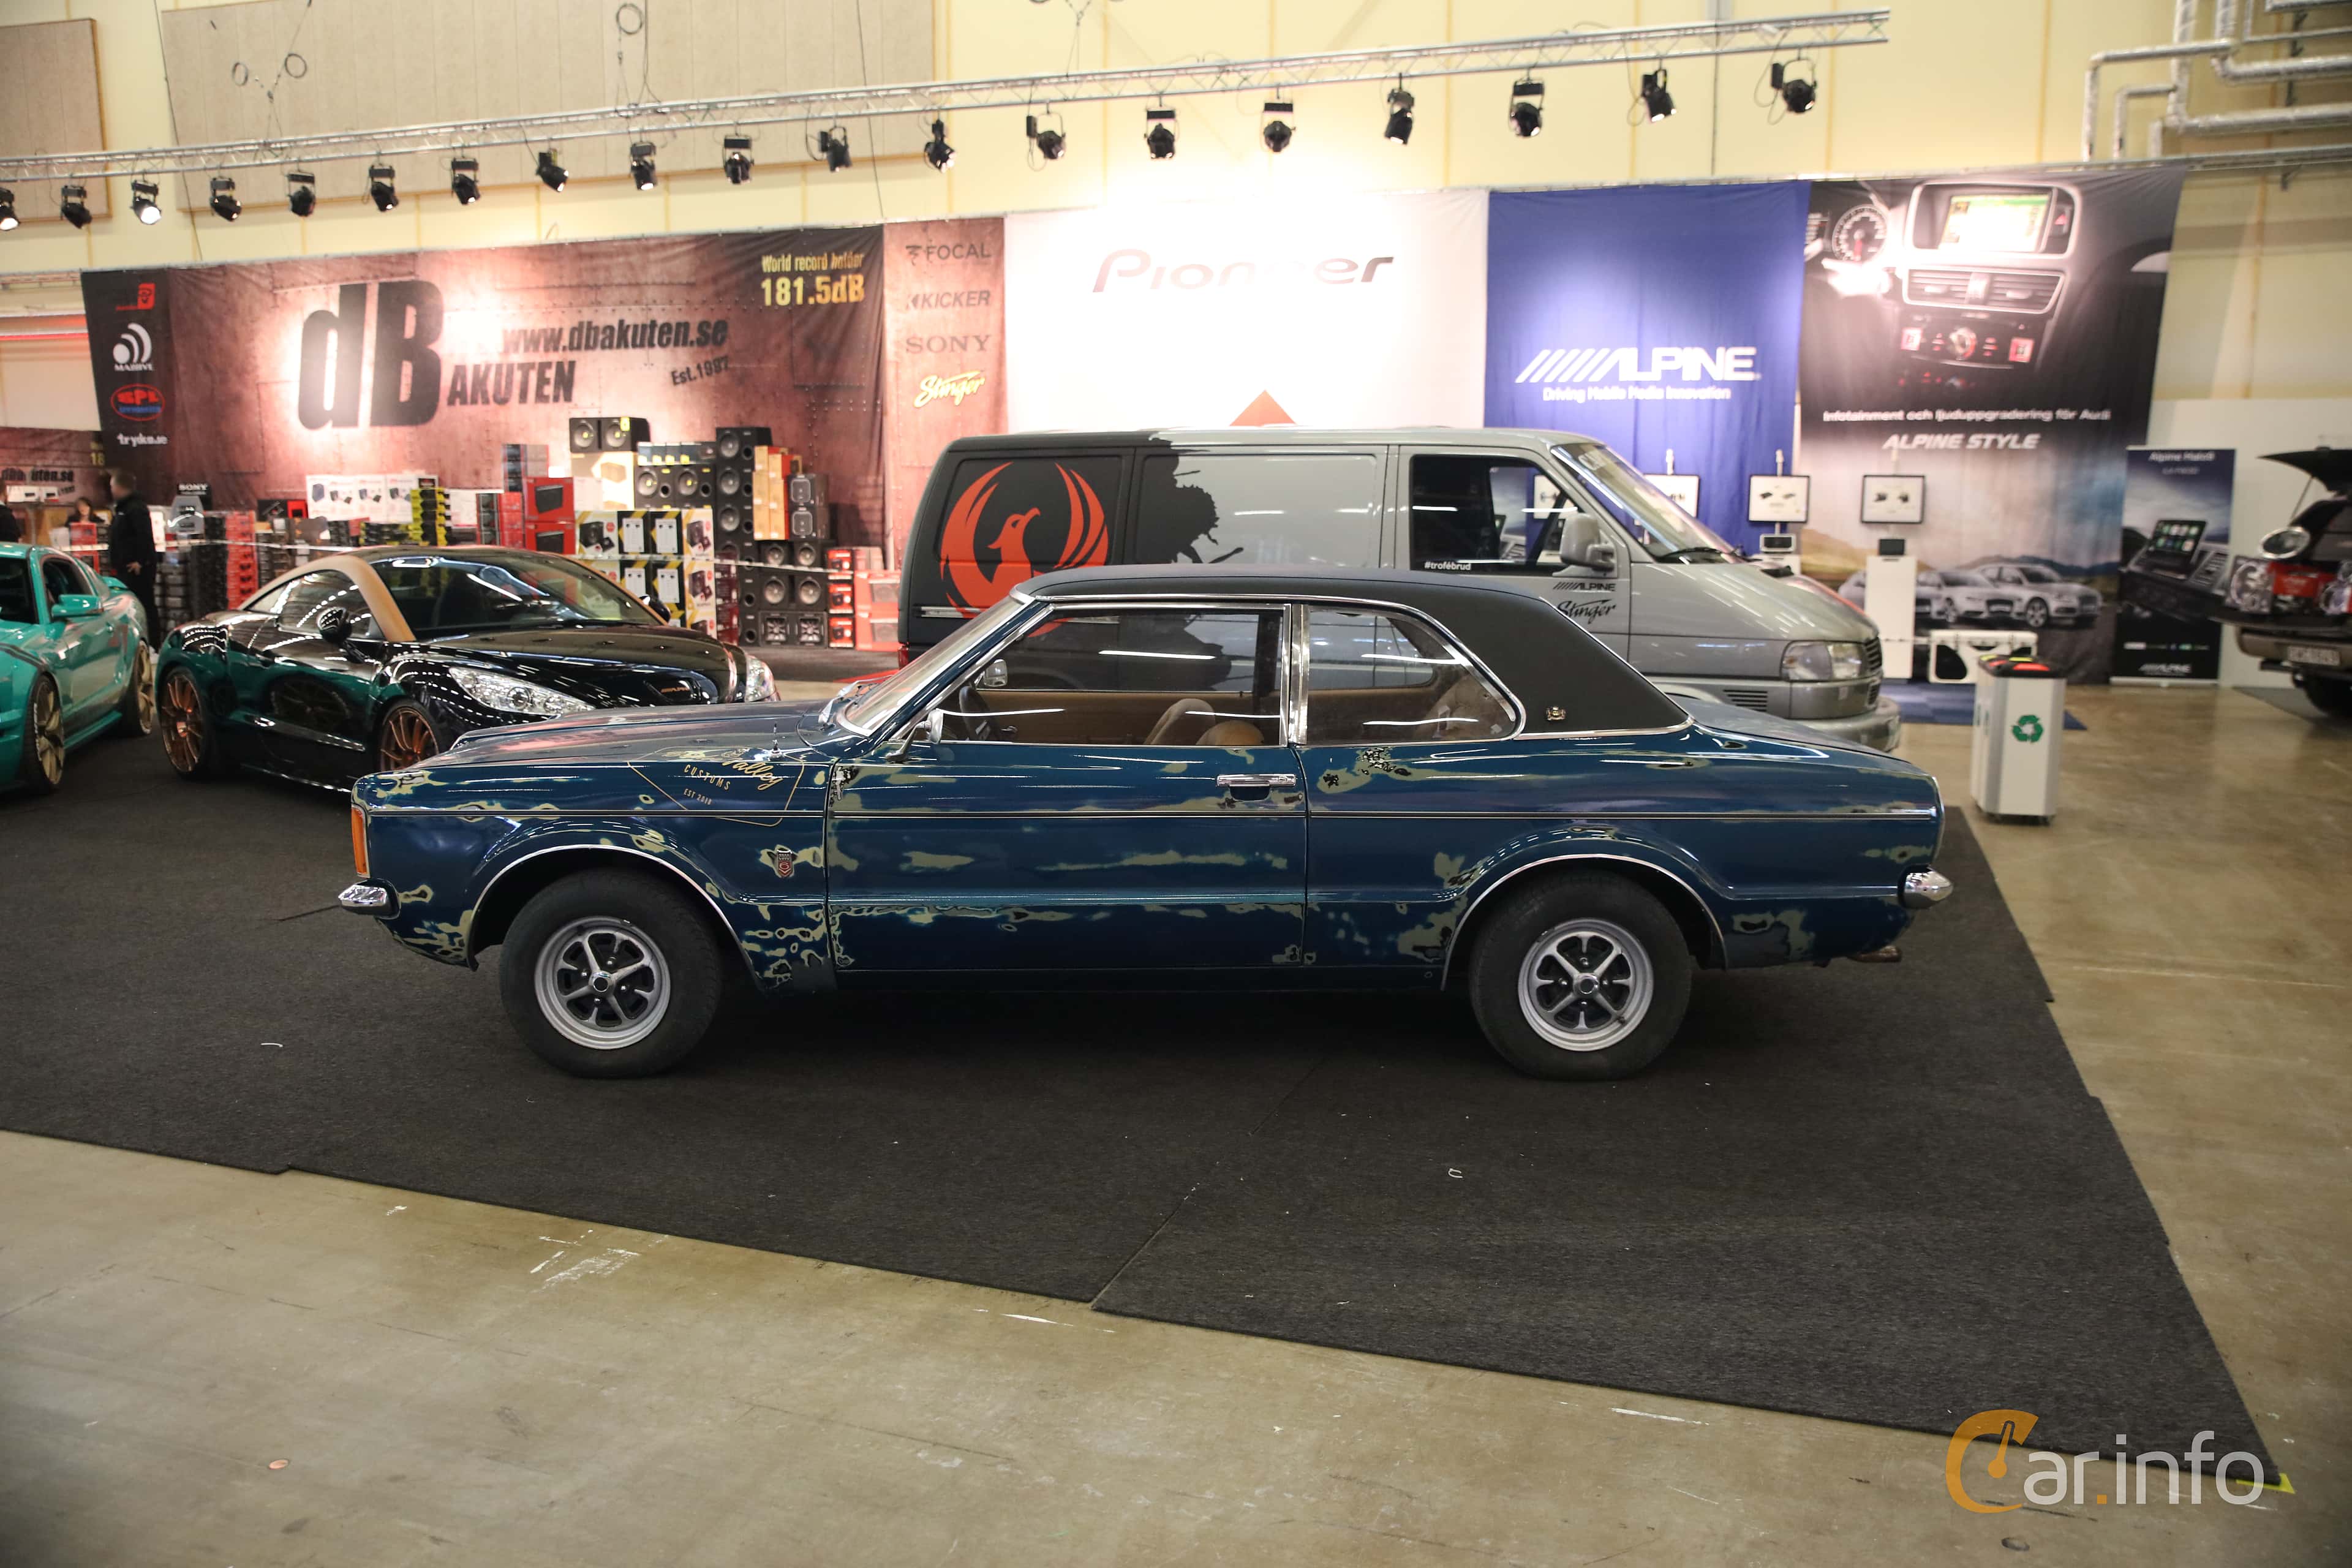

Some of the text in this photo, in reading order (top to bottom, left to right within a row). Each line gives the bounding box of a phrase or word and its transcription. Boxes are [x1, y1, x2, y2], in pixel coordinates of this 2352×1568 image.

[761, 253, 792, 273] World
[794, 252, 828, 271] record
[925, 244, 992, 261] FOCAL
[1093, 249, 1395, 293] Pioner
[761, 273, 865, 306] 181.5dB
[502, 318, 729, 353] www.dbakuten.se
[906, 335, 991, 353] SONY
[1588, 346, 1757, 382] ALPINE
[447, 360, 576, 405] AKUTEN
[913, 370, 986, 408] Stinger
[1881, 434, 2041, 450] ALPINE STYLE
[1575, 582, 1616, 592] ALPINE
[1556, 599, 1616, 624] Stinger
[684, 764, 731, 791] CUSTOMS
[683, 788, 696, 799] EST
